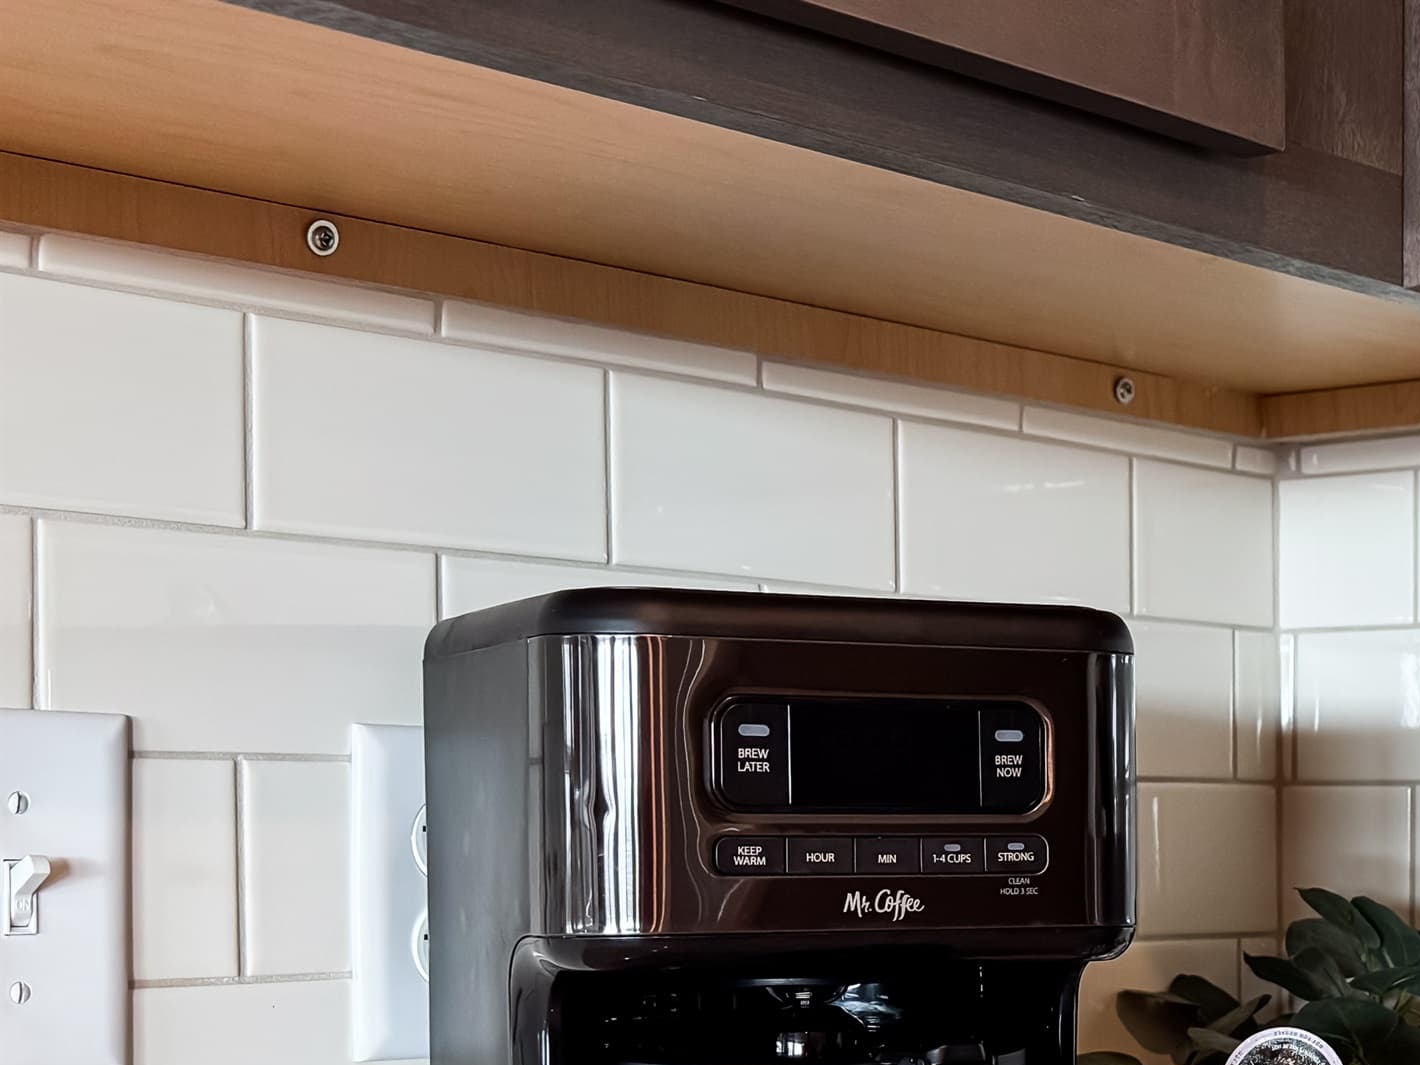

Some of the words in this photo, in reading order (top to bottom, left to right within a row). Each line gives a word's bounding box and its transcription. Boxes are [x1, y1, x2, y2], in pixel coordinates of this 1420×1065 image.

[737, 748, 769, 760] BREW
[994, 755, 1023, 766] BREW
[737, 761, 770, 773] LATER
[996, 767, 1022, 778] NOW
[738, 846, 762, 856] KEEP
[733, 856, 767, 866] WARM
[806, 852, 835, 864] HOUR
[877, 853, 897, 864] MIN
[932, 853, 945, 863] 1-4
[947, 853, 972, 864] CUPS
[997, 851, 1035, 863] STRONG
[1008, 877, 1030, 886] CLEAN
[1000, 887, 1019, 896] HOLD
[1025, 887, 1039, 896] SEC
[843, 891, 873, 913] Mr.
[874, 889, 925, 922] Coffee
